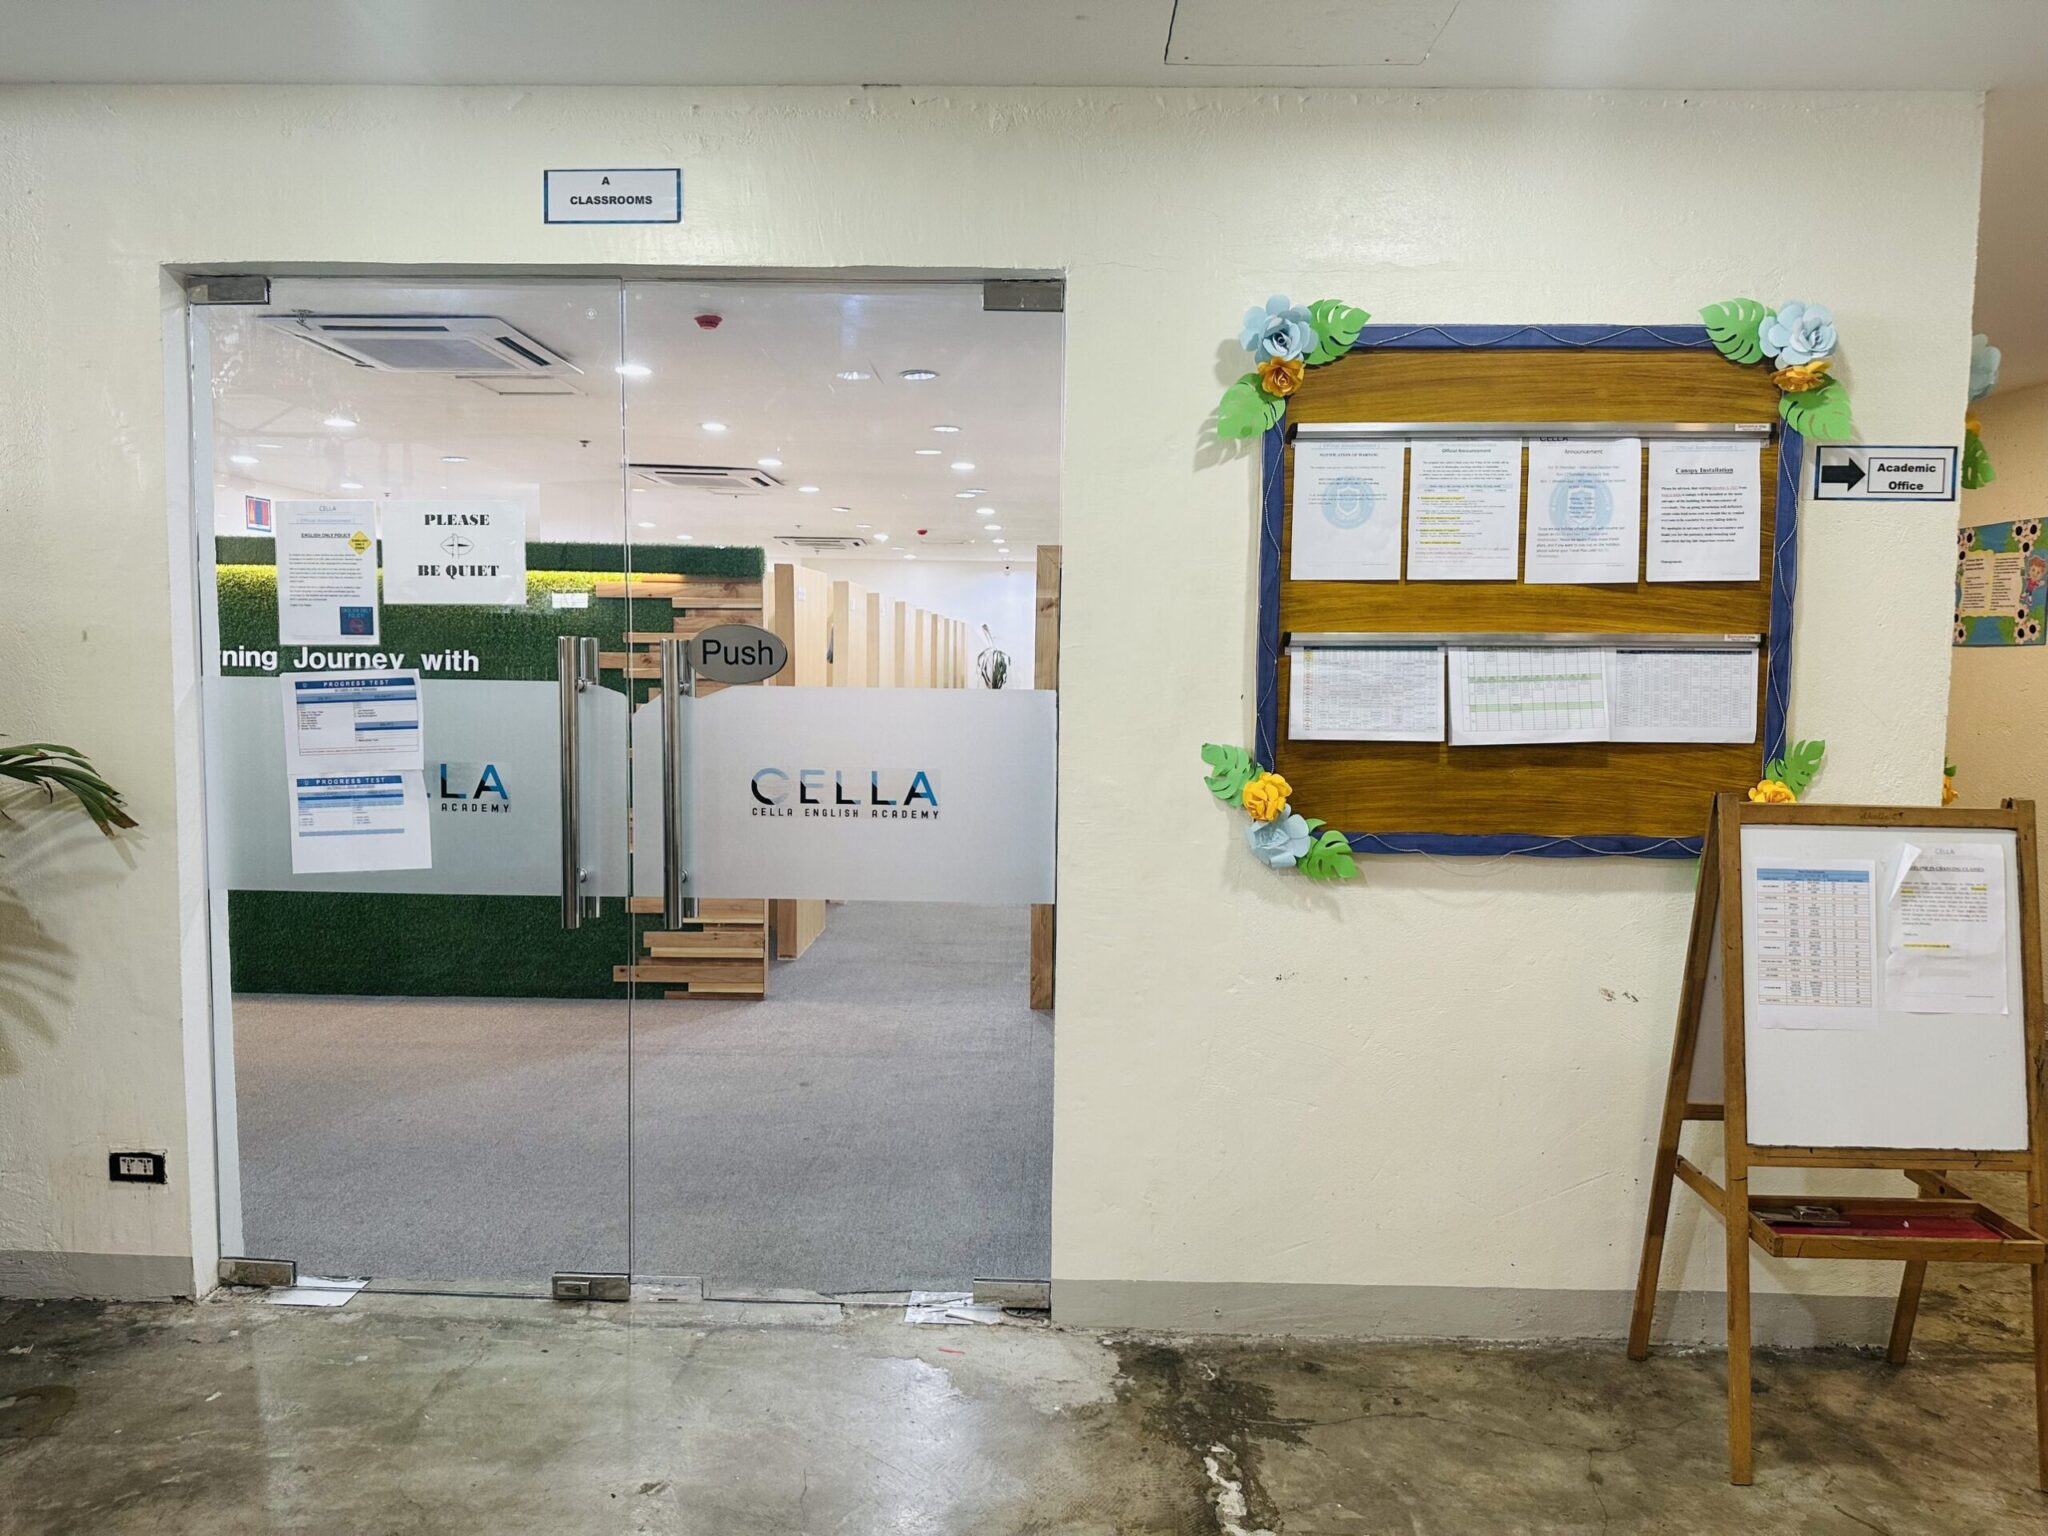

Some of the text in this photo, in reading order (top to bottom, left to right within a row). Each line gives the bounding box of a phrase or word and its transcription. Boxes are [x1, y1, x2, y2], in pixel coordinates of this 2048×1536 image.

[601, 176, 611, 186] A
[569, 195, 653, 205] CLASSROOMS
[1877, 463, 1937, 473] Academic
[1888, 480, 1924, 491] Office
[424, 513, 491, 526] PLEASE
[417, 564, 500, 580] BE QUIET
[702, 639, 774, 665] Push
[220, 645, 480, 672] ning Journey with
[323, 680, 366, 688] PROGRESS
[315, 778, 361, 786] PROGRESS
[751, 767, 938, 807] CELLA
[441, 803, 510, 813] ACADEMY
[752, 807, 940, 820] CELLA ENGLISH ACADEMY
